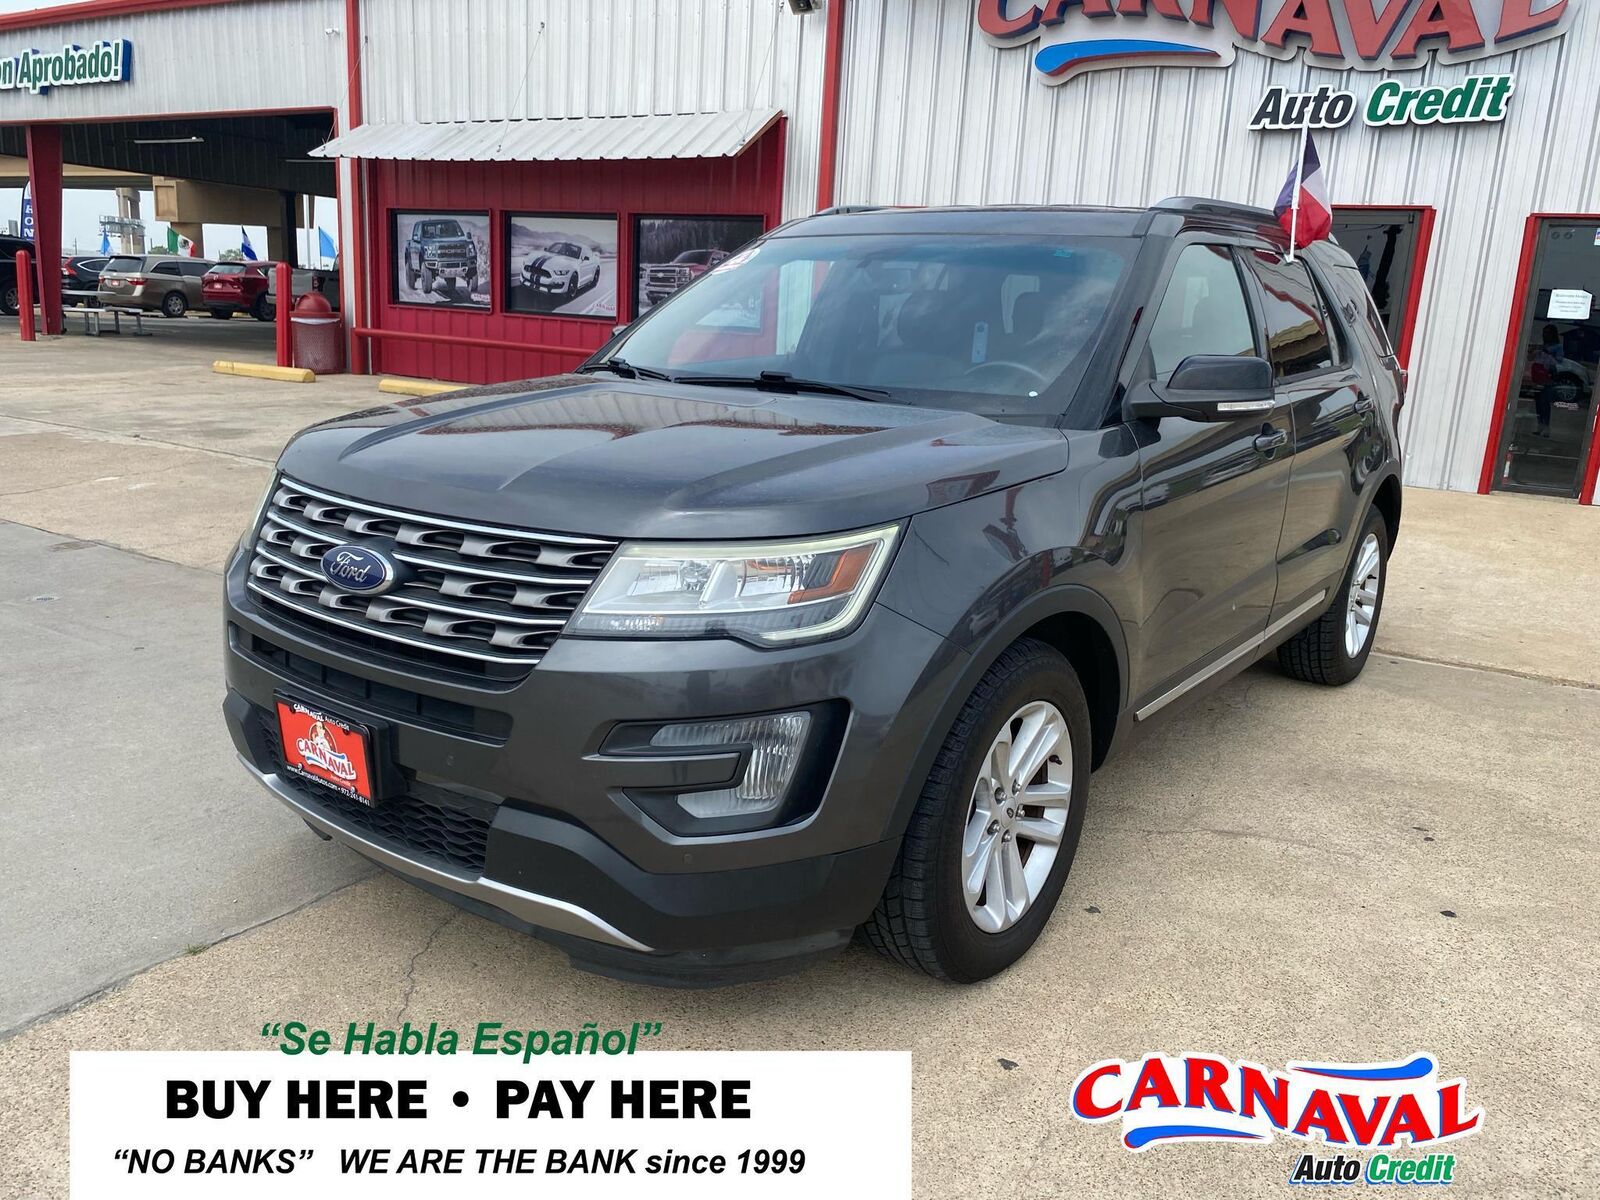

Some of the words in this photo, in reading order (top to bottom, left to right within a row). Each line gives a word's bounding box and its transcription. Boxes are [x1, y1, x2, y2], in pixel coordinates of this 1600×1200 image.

[18, 42, 120, 91] Aprobado!
[1250, 87, 1355, 125] Auto
[1366, 76, 1512, 123] Credit
[330, 551, 371, 582] Ford
[297, 738, 355, 777] CARNAVAL
